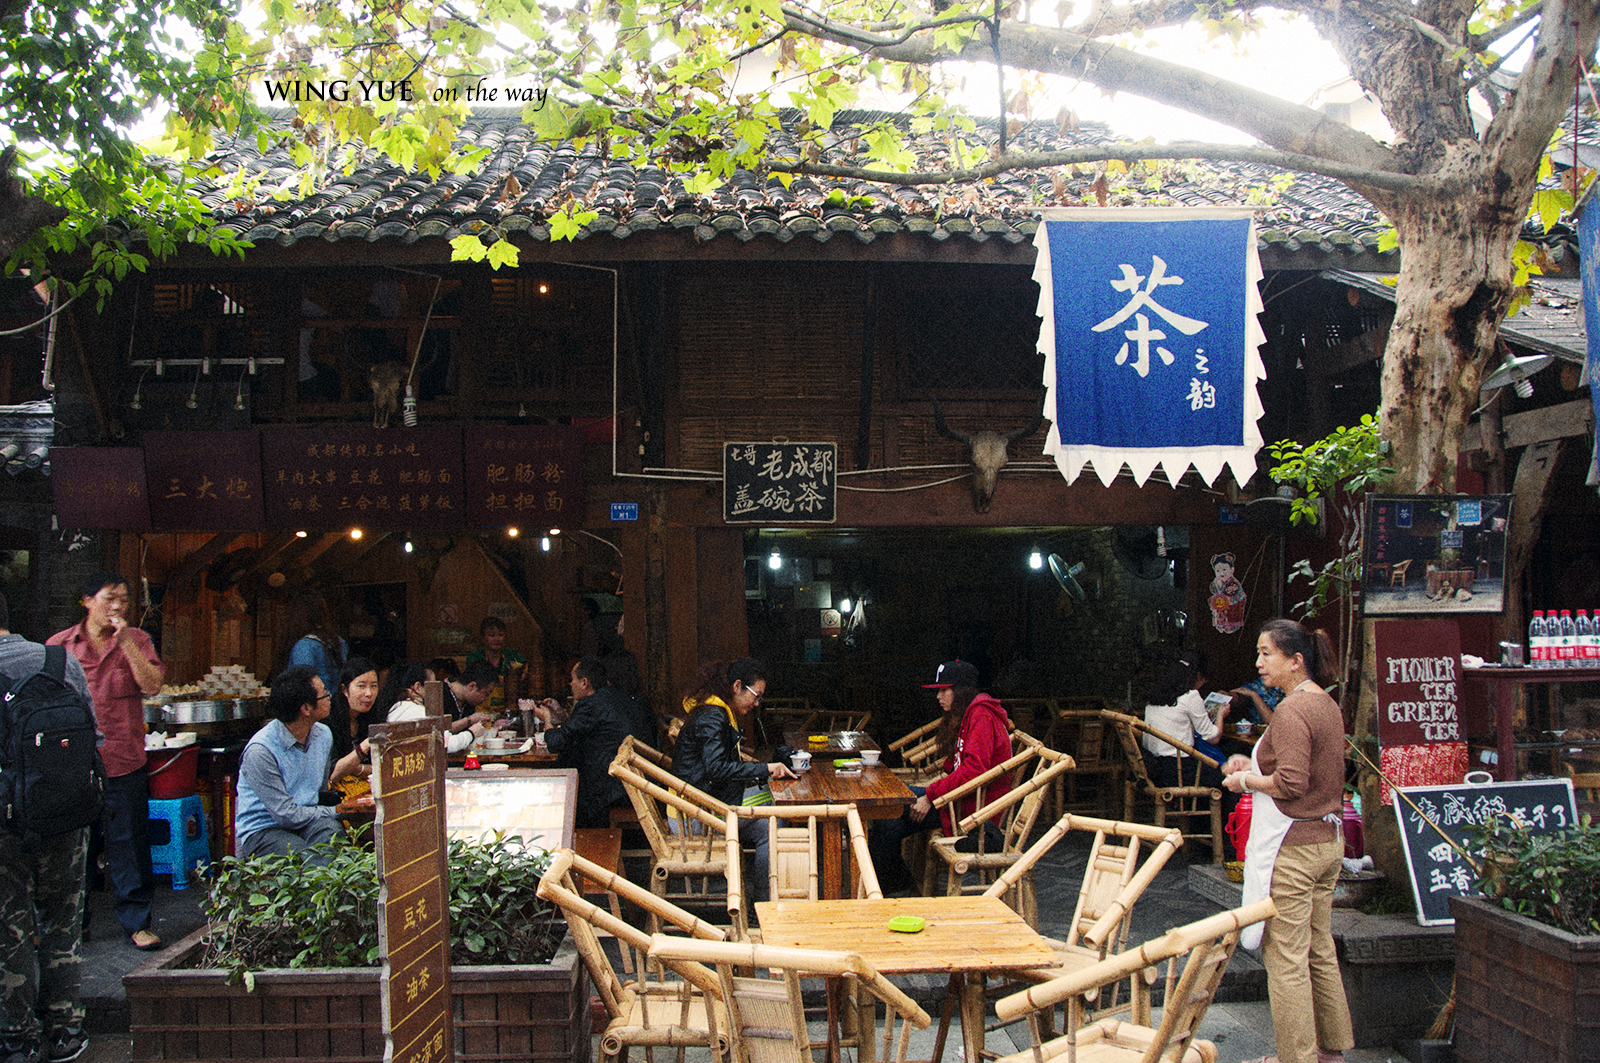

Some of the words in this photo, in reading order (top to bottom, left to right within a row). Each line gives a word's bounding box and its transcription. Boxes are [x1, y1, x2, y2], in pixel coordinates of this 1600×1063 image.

[1091, 254, 1210, 378] 茶
[1186, 348, 1216, 411] 之韵
[307, 442, 420, 459] 成都传统名小吃
[348, 468, 383, 486] 豆花
[398, 468, 451, 485] 肥肠面
[486, 461, 565, 484] 肥肠粉
[757, 446, 833, 486] 老成都
[165, 475, 251, 499] 三大炮
[731, 481, 826, 515] 盖碗茶
[288, 494, 323, 512] 油茶
[485, 490, 563, 512] 担担面
[1386, 657, 1457, 683] FLOWER
[1420, 682, 1458, 701] TEA
[1388, 701, 1458, 723] GREEN
[1420, 723, 1460, 740] TEA
[392, 752, 426, 778] 肥肠粉
[403, 898, 428, 931] 豆花
[406, 966, 430, 1003] 油茶
